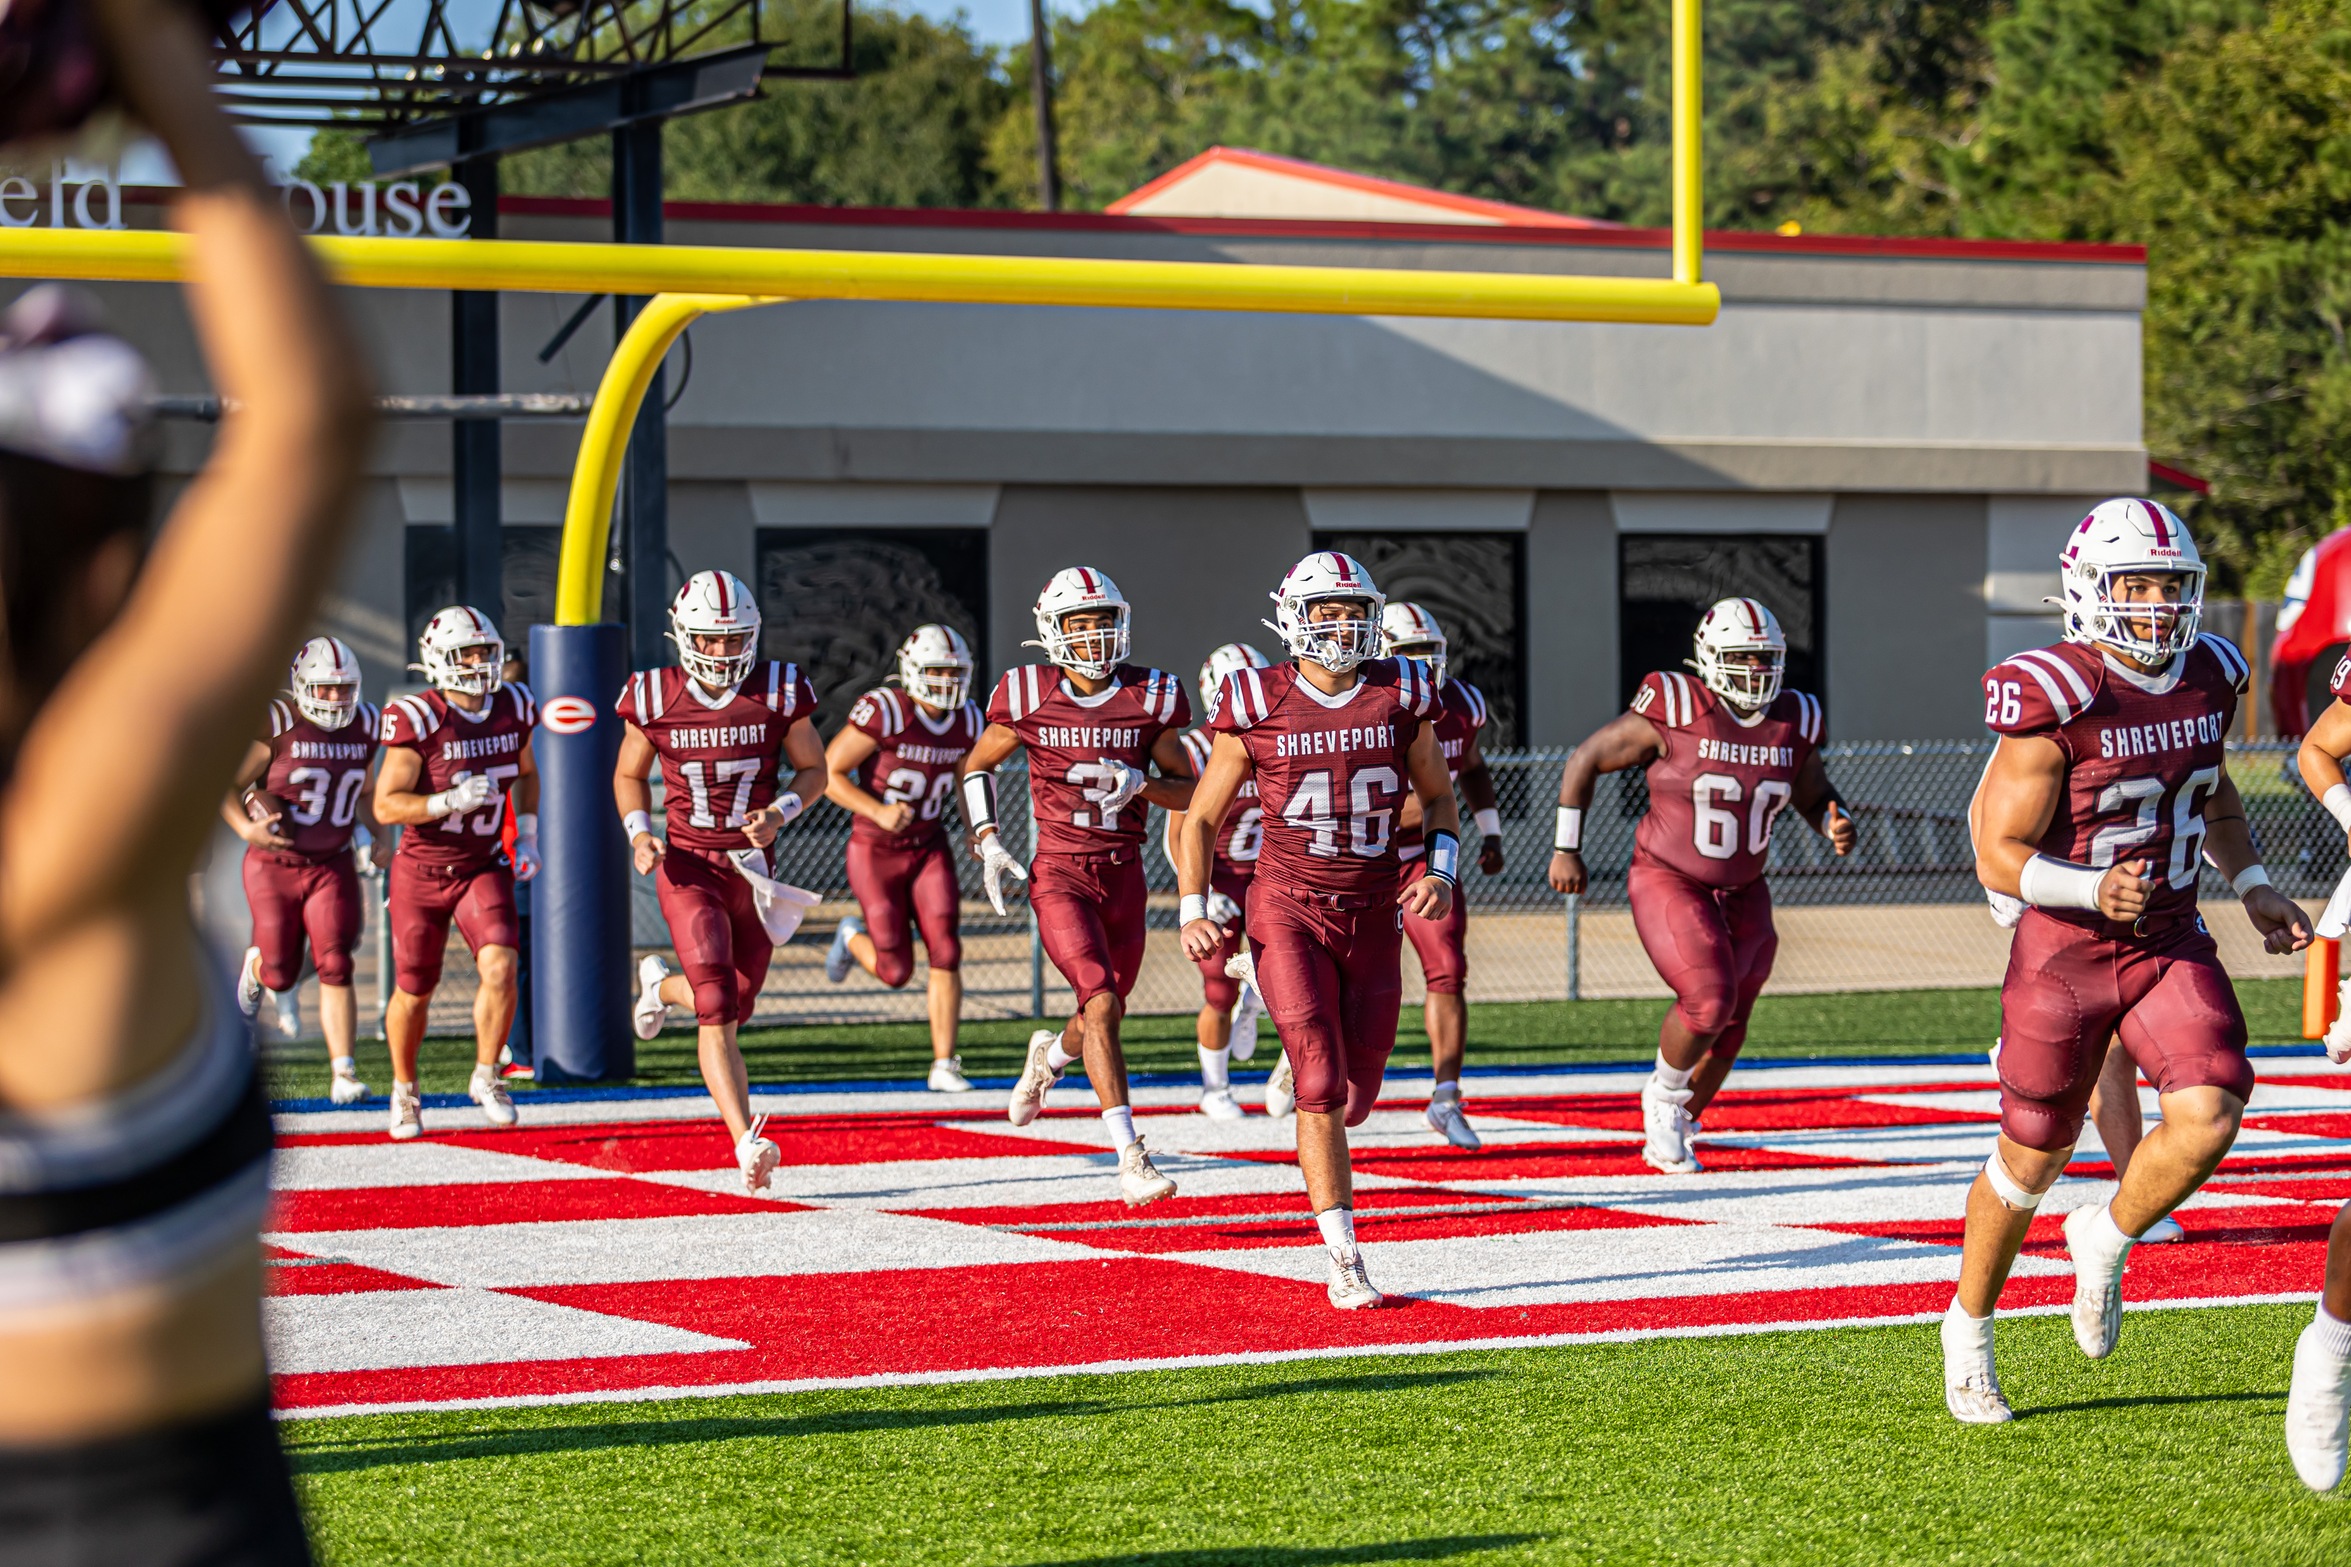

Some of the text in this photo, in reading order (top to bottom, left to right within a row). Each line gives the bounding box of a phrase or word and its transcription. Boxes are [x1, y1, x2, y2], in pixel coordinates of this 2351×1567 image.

[252, 156, 472, 238] ouse
[2150, 548, 2182, 557] Riddell
[1985, 679, 2022, 725] 26
[379, 714, 399, 741] 15
[443, 733, 520, 761] SHREVEPORT
[670, 724, 766, 749] SHREVEPORT
[1038, 727, 1140, 748] SHREVEPORT
[1277, 725, 1395, 757] SHREVEPORT
[2101, 711, 2223, 758] SHREVEPORT
[291, 741, 367, 760] SHREVEPORT
[1698, 738, 1793, 767] SHREVEPORT
[289, 767, 366, 827] 30
[680, 757, 761, 828] 17
[1283, 766, 1399, 857] 46
[1693, 773, 1792, 860] 60
[2091, 764, 2220, 891] 26
